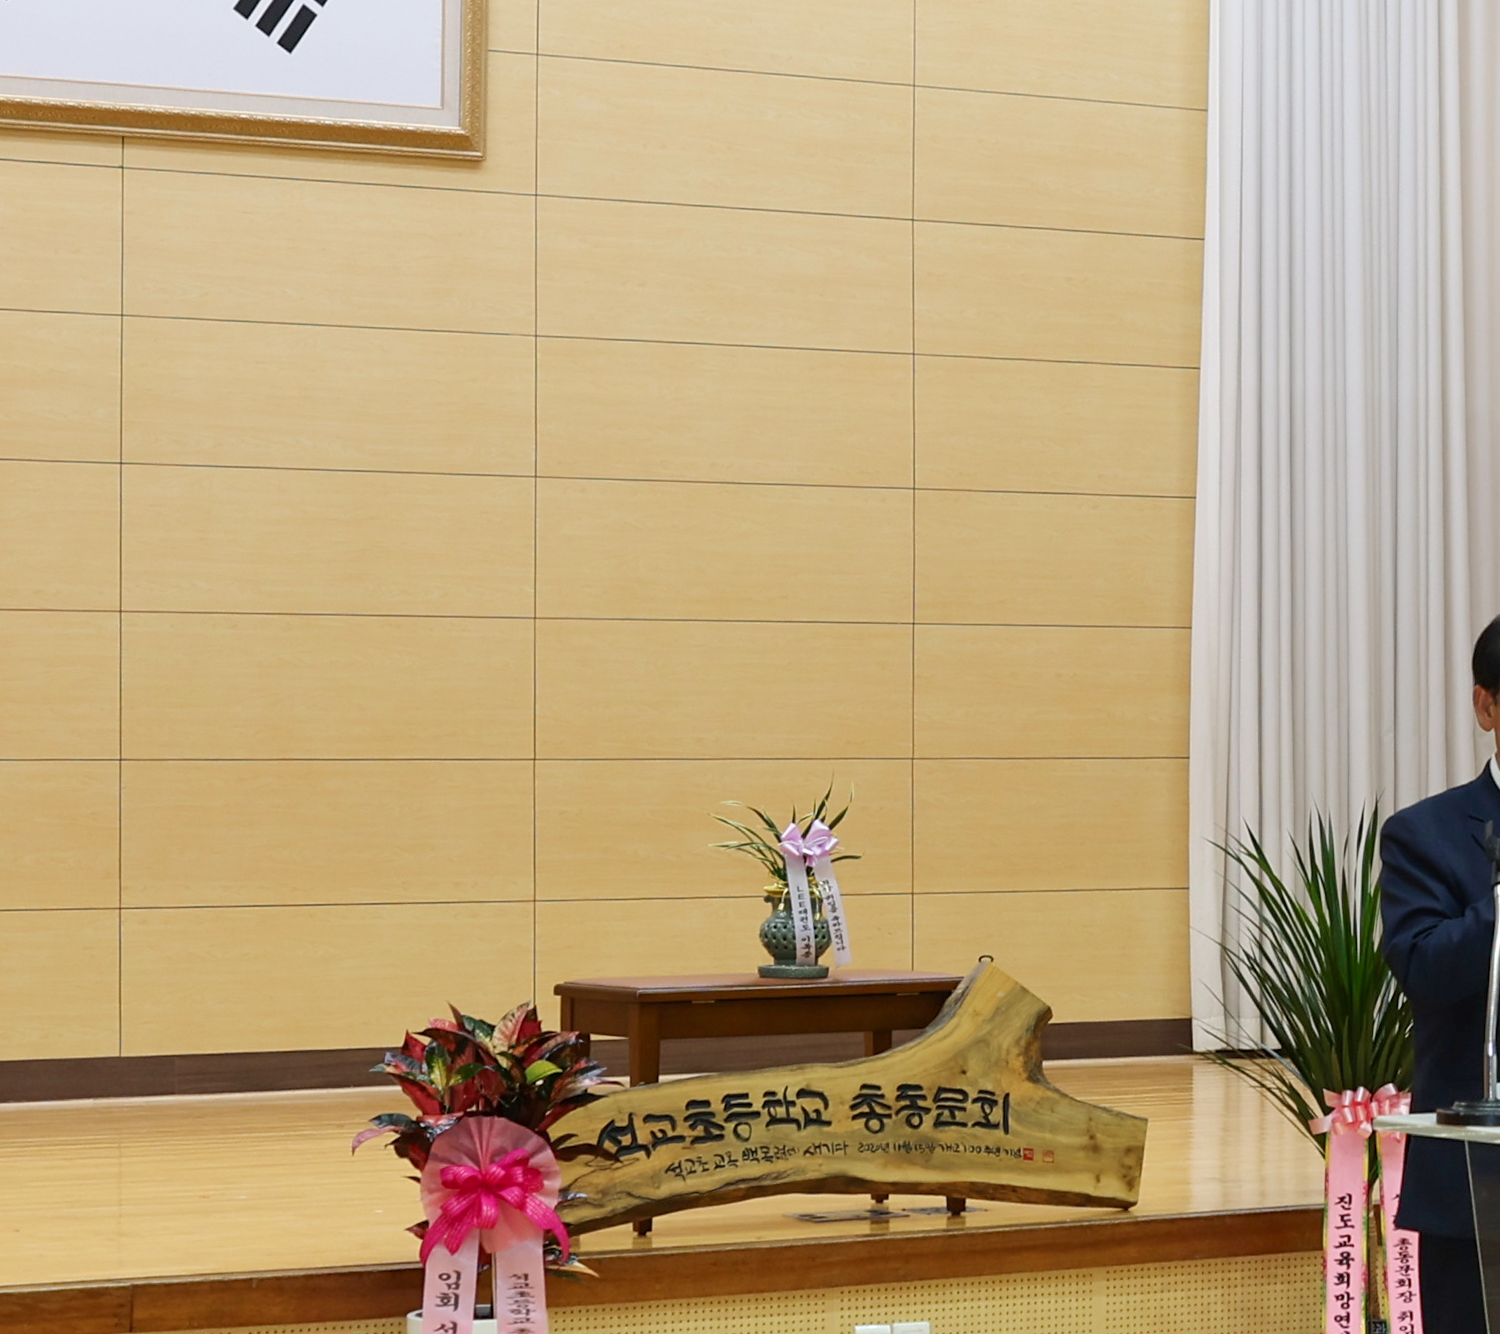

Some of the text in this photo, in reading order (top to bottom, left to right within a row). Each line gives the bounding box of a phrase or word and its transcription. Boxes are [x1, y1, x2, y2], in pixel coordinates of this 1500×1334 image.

[596, 1082, 1011, 1159] 석교초등학교 총동문회
[1393, 1236, 1418, 1304] 총동문회장
